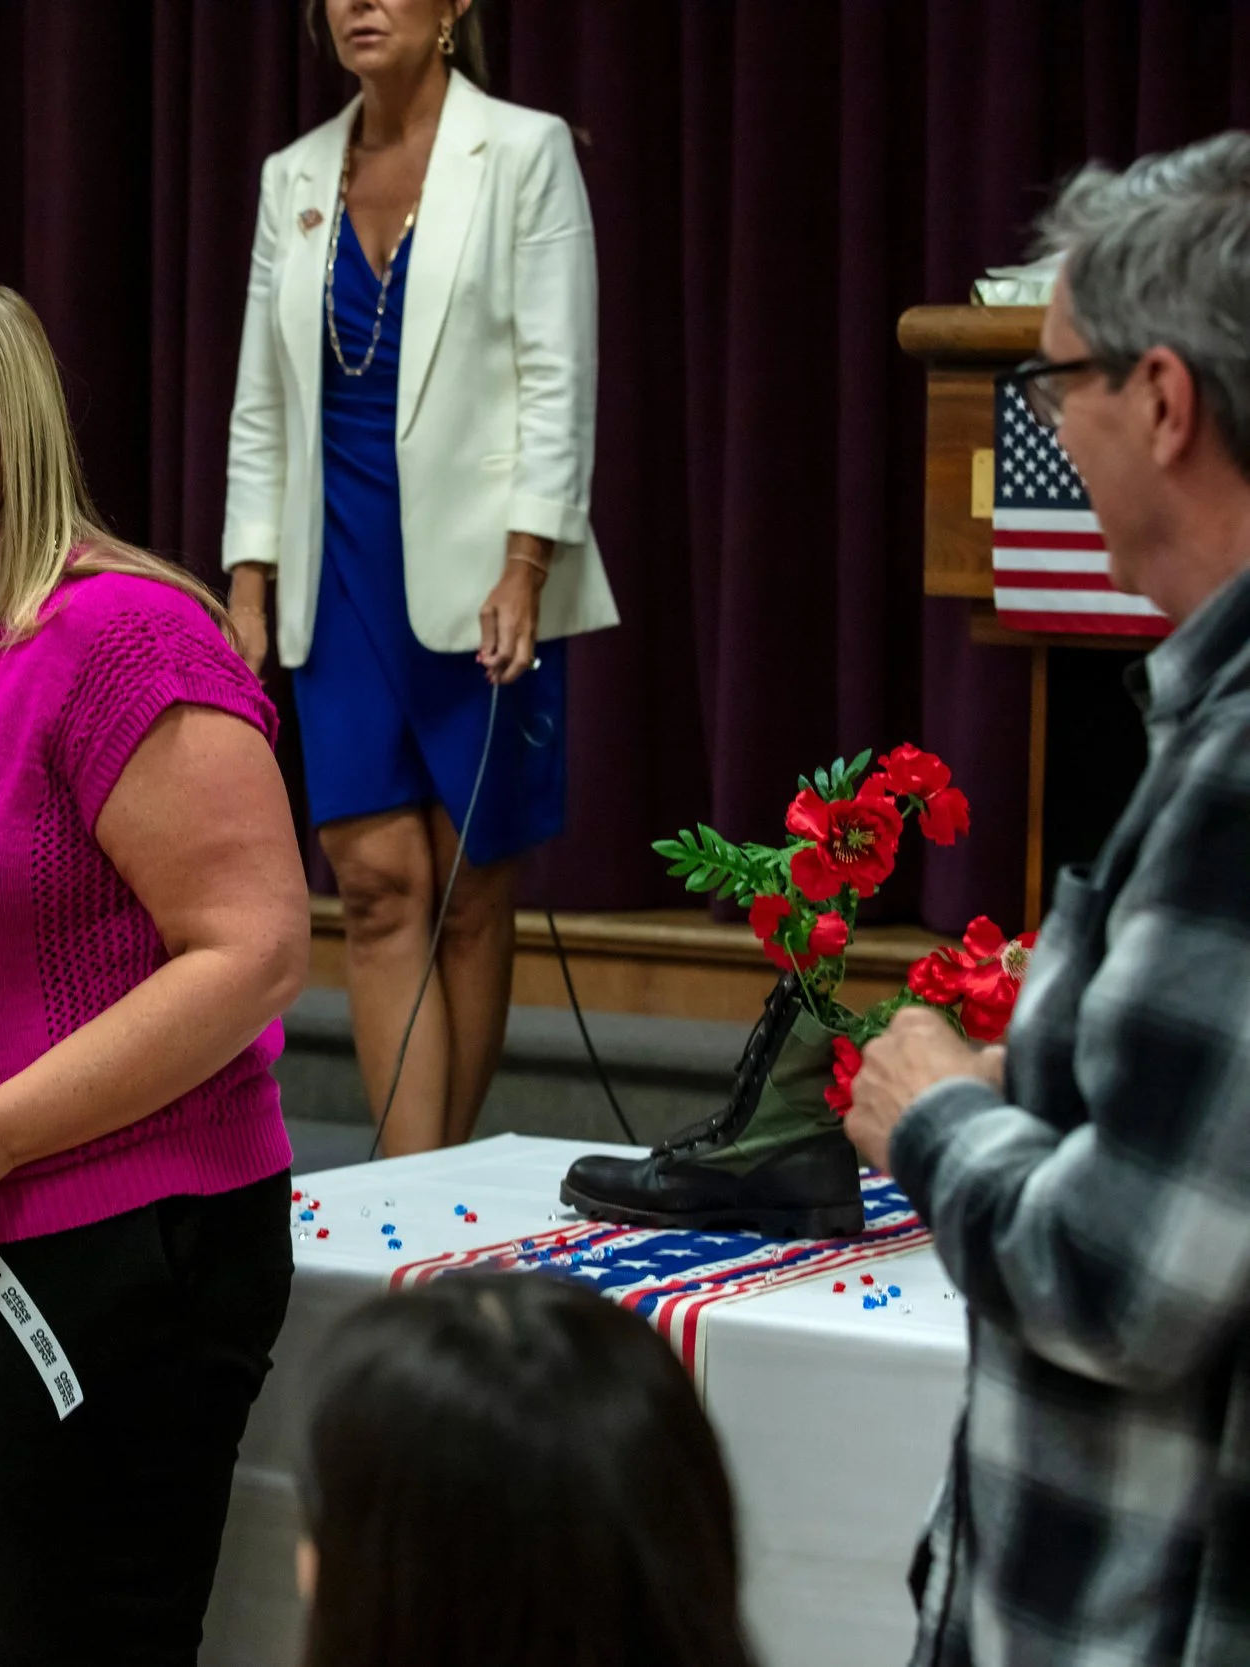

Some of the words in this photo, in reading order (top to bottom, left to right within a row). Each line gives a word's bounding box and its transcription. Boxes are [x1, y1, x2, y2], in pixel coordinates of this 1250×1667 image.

[1, 1291, 26, 1326] DEPOT
[7, 1286, 32, 1321] Office
[30, 1333, 52, 1368] DEPOT
[36, 1328, 57, 1364] Office
[60, 1371, 75, 1405] Office
